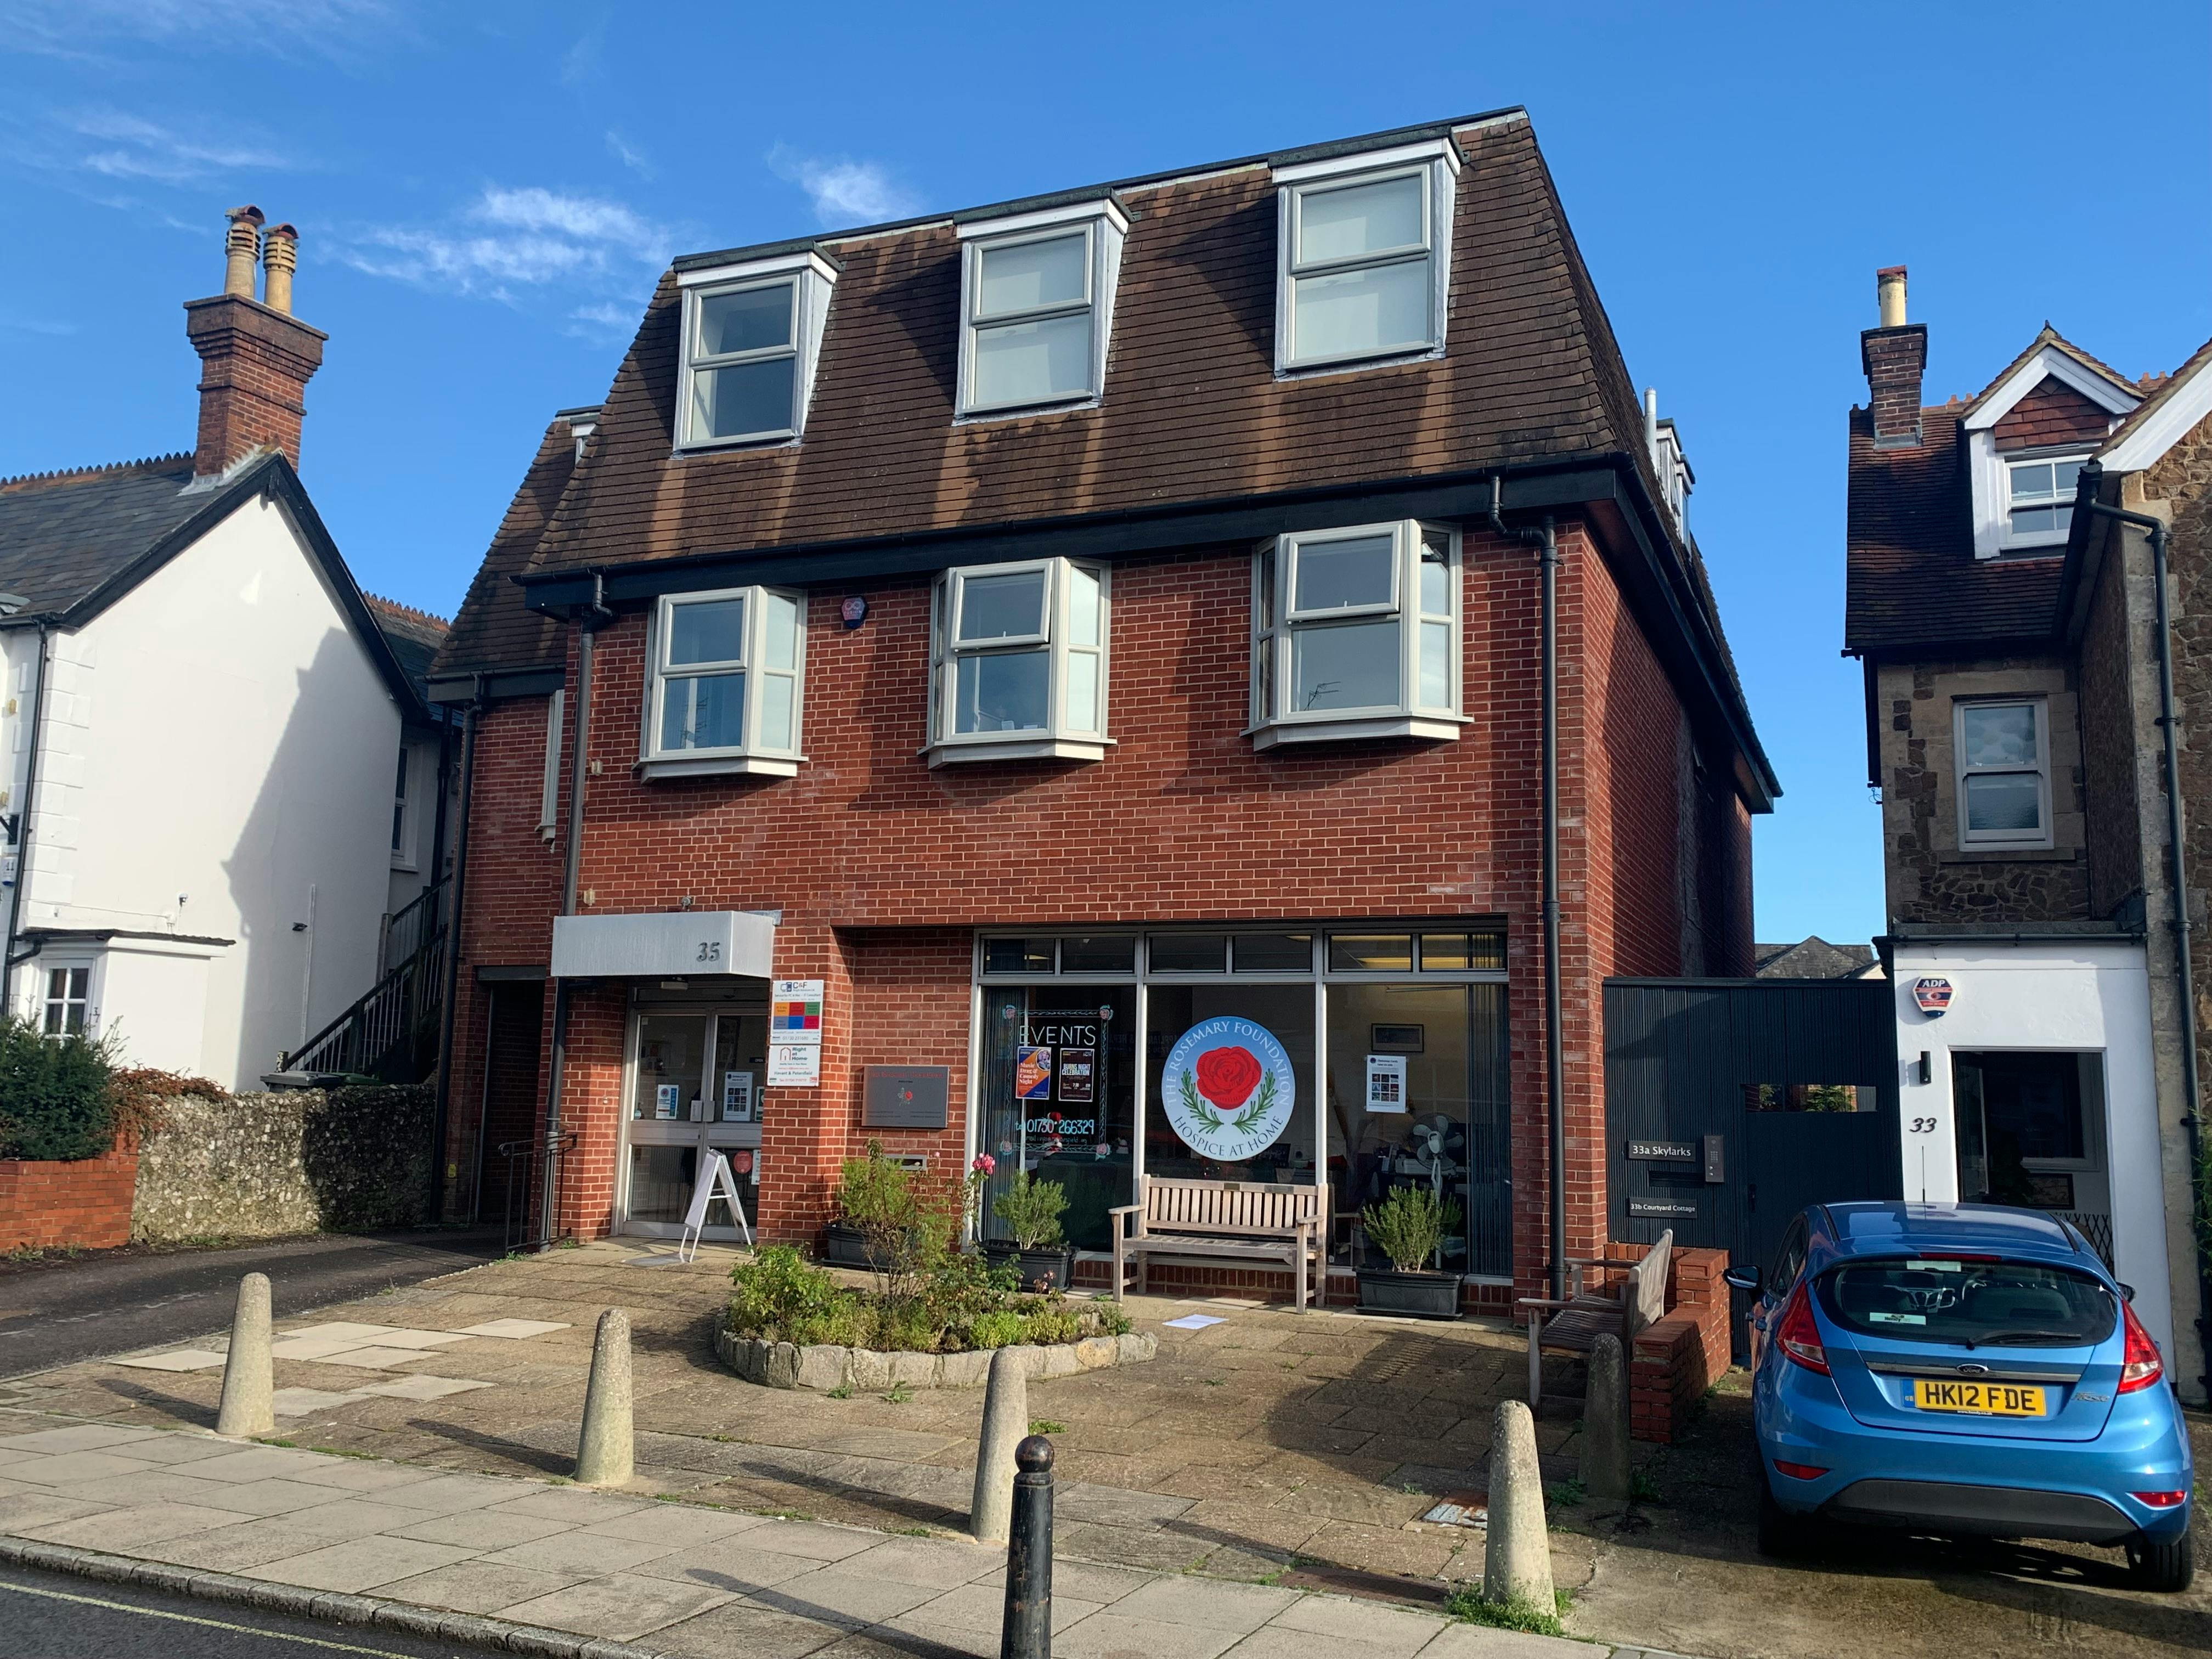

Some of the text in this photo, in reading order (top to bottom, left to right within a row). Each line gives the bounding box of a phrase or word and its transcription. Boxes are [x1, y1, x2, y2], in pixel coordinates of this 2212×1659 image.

[696, 941, 720, 962] 35
[1019, 1025, 1096, 1046] EVENTS
[1166, 1021, 1291, 1107] THE ROSEMARY FOUNDATION
[1027, 1119, 1054, 1133] 01730
[1058, 1119, 1095, 1135] 266329
[1174, 1115, 1284, 1156] HOSPICE AT HOME
[1909, 1117, 1937, 1133] 33
[1632, 1145, 1691, 1157] 33a Skylarks
[1925, 1383, 2036, 1412] HK12 FDE
